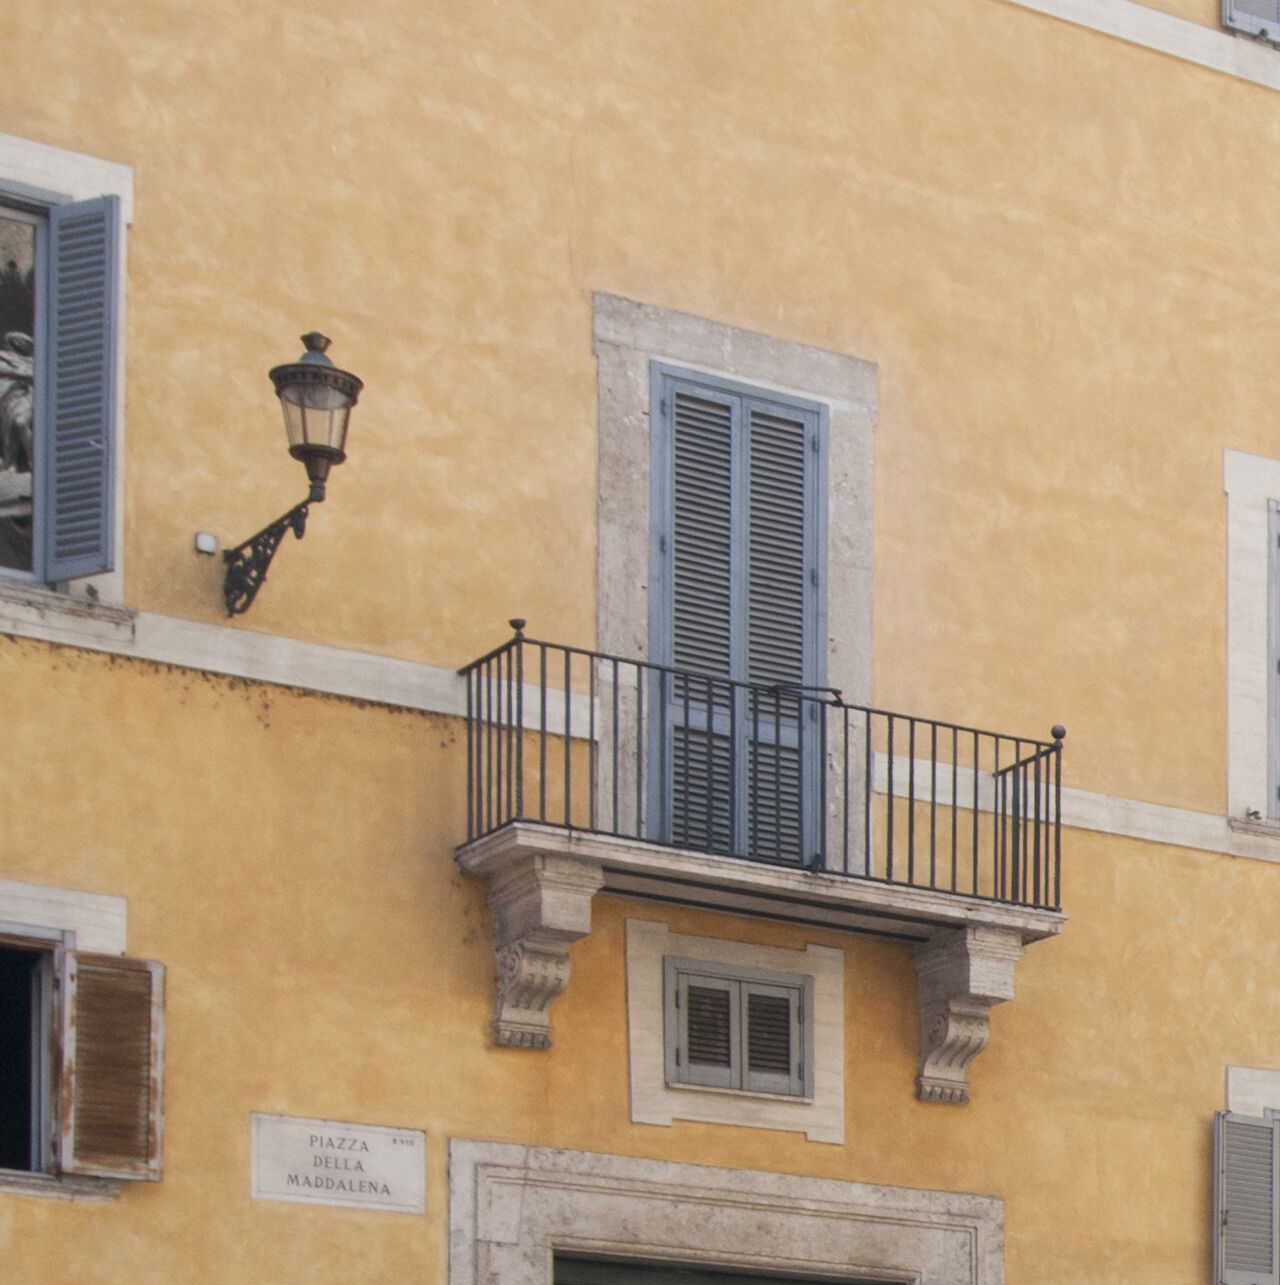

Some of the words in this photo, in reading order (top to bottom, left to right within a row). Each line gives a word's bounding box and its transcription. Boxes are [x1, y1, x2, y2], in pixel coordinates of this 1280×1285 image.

[309, 1134, 370, 1153] PIAZZA
[313, 1155, 365, 1172] DELLA
[287, 1173, 391, 1196] MADDALENA
